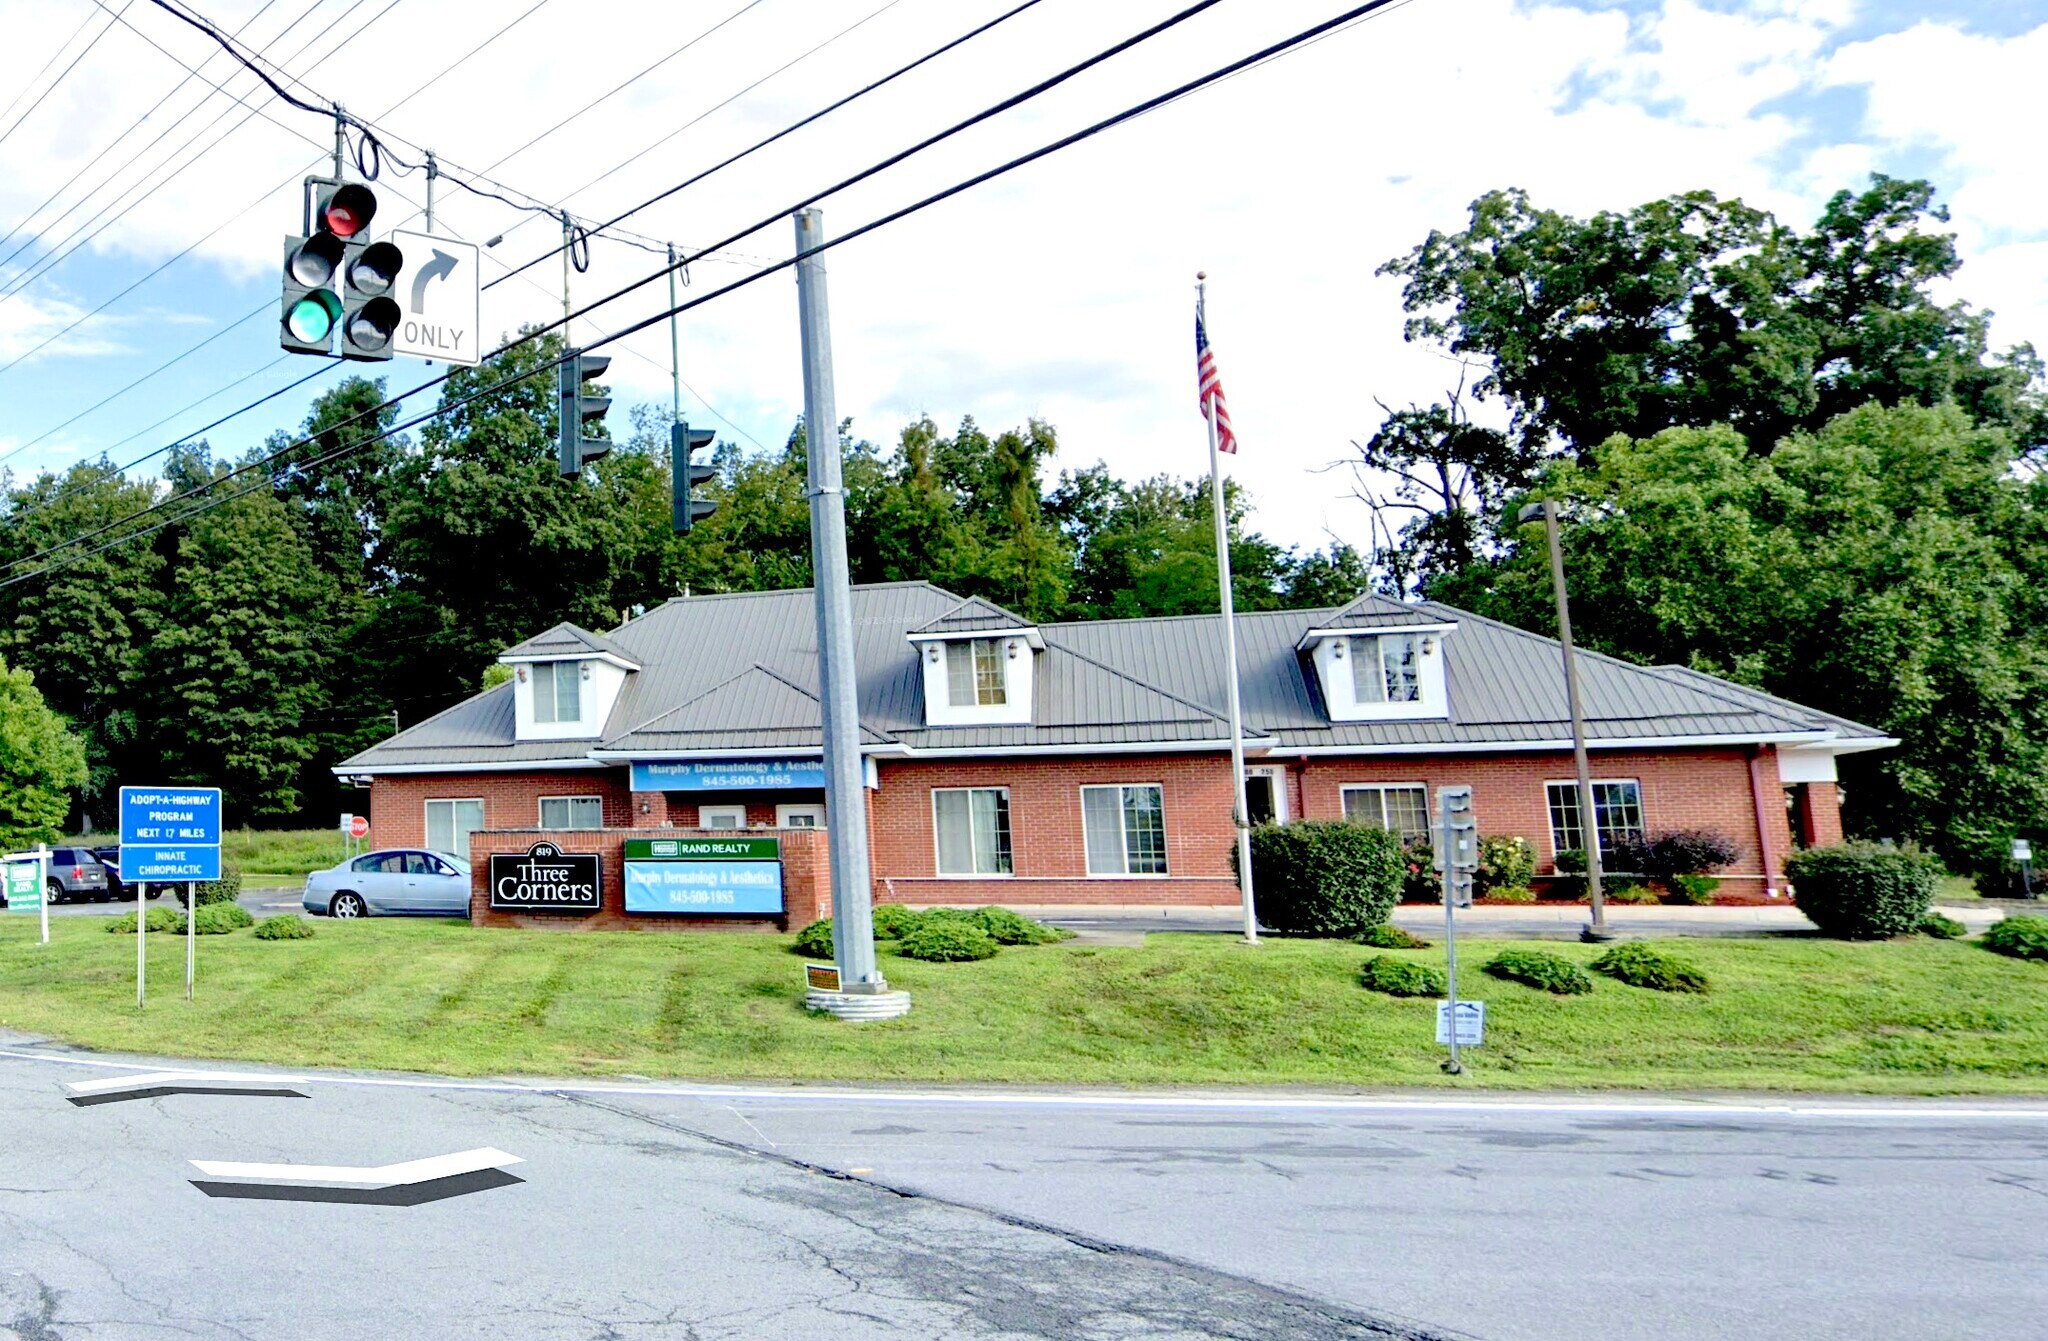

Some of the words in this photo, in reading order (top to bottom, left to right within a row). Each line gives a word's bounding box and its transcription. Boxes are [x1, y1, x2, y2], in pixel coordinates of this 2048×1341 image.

[404, 321, 463, 350] ONLY
[648, 764, 691, 775] Murphy
[695, 761, 769, 774] Dermatology
[773, 762, 782, 772] &
[702, 774, 792, 786] 845-500-1985
[130, 795, 211, 805] ADOPT-A-HIGHWAY
[149, 811, 193, 821] PROGRAM
[137, 828, 160, 837] NEXT
[180, 828, 205, 837] MILES
[350, 823, 366, 831] STOP
[535, 847, 552, 857] 819
[682, 844, 711, 854] RAND
[712, 843, 751, 853] REALTY
[155, 851, 186, 861] INNATE
[139, 865, 202, 875] CHIROPRACTIC
[517, 858, 570, 882] Three
[631, 871, 662, 888] Murphy
[664, 871, 717, 887] Dermatology
[720, 872, 726, 883] &
[729, 871, 774, 884] Aesthetics
[497, 876, 593, 901] Corners
[669, 890, 735, 904] 845-500-1985
